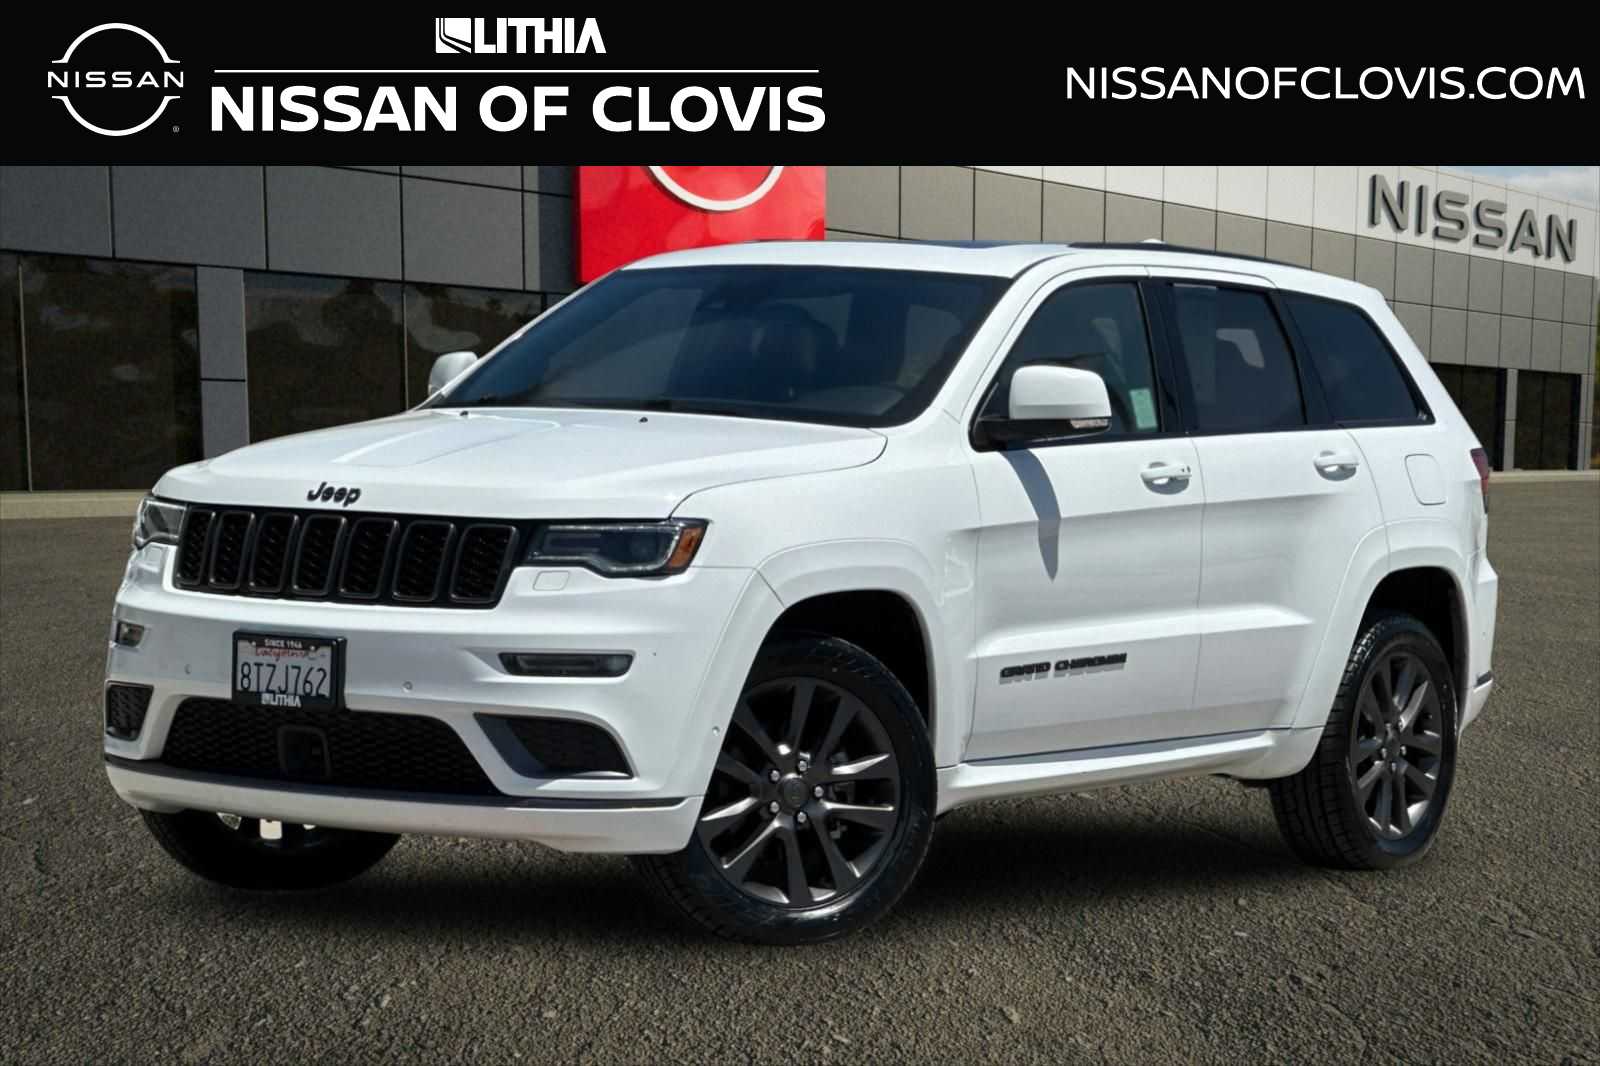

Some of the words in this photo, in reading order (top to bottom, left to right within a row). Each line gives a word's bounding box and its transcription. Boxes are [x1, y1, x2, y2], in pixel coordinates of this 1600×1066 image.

[1369, 174, 1578, 263] NISSAN
[306, 481, 361, 507] Jeep
[240, 661, 328, 697] 8TZJ762
